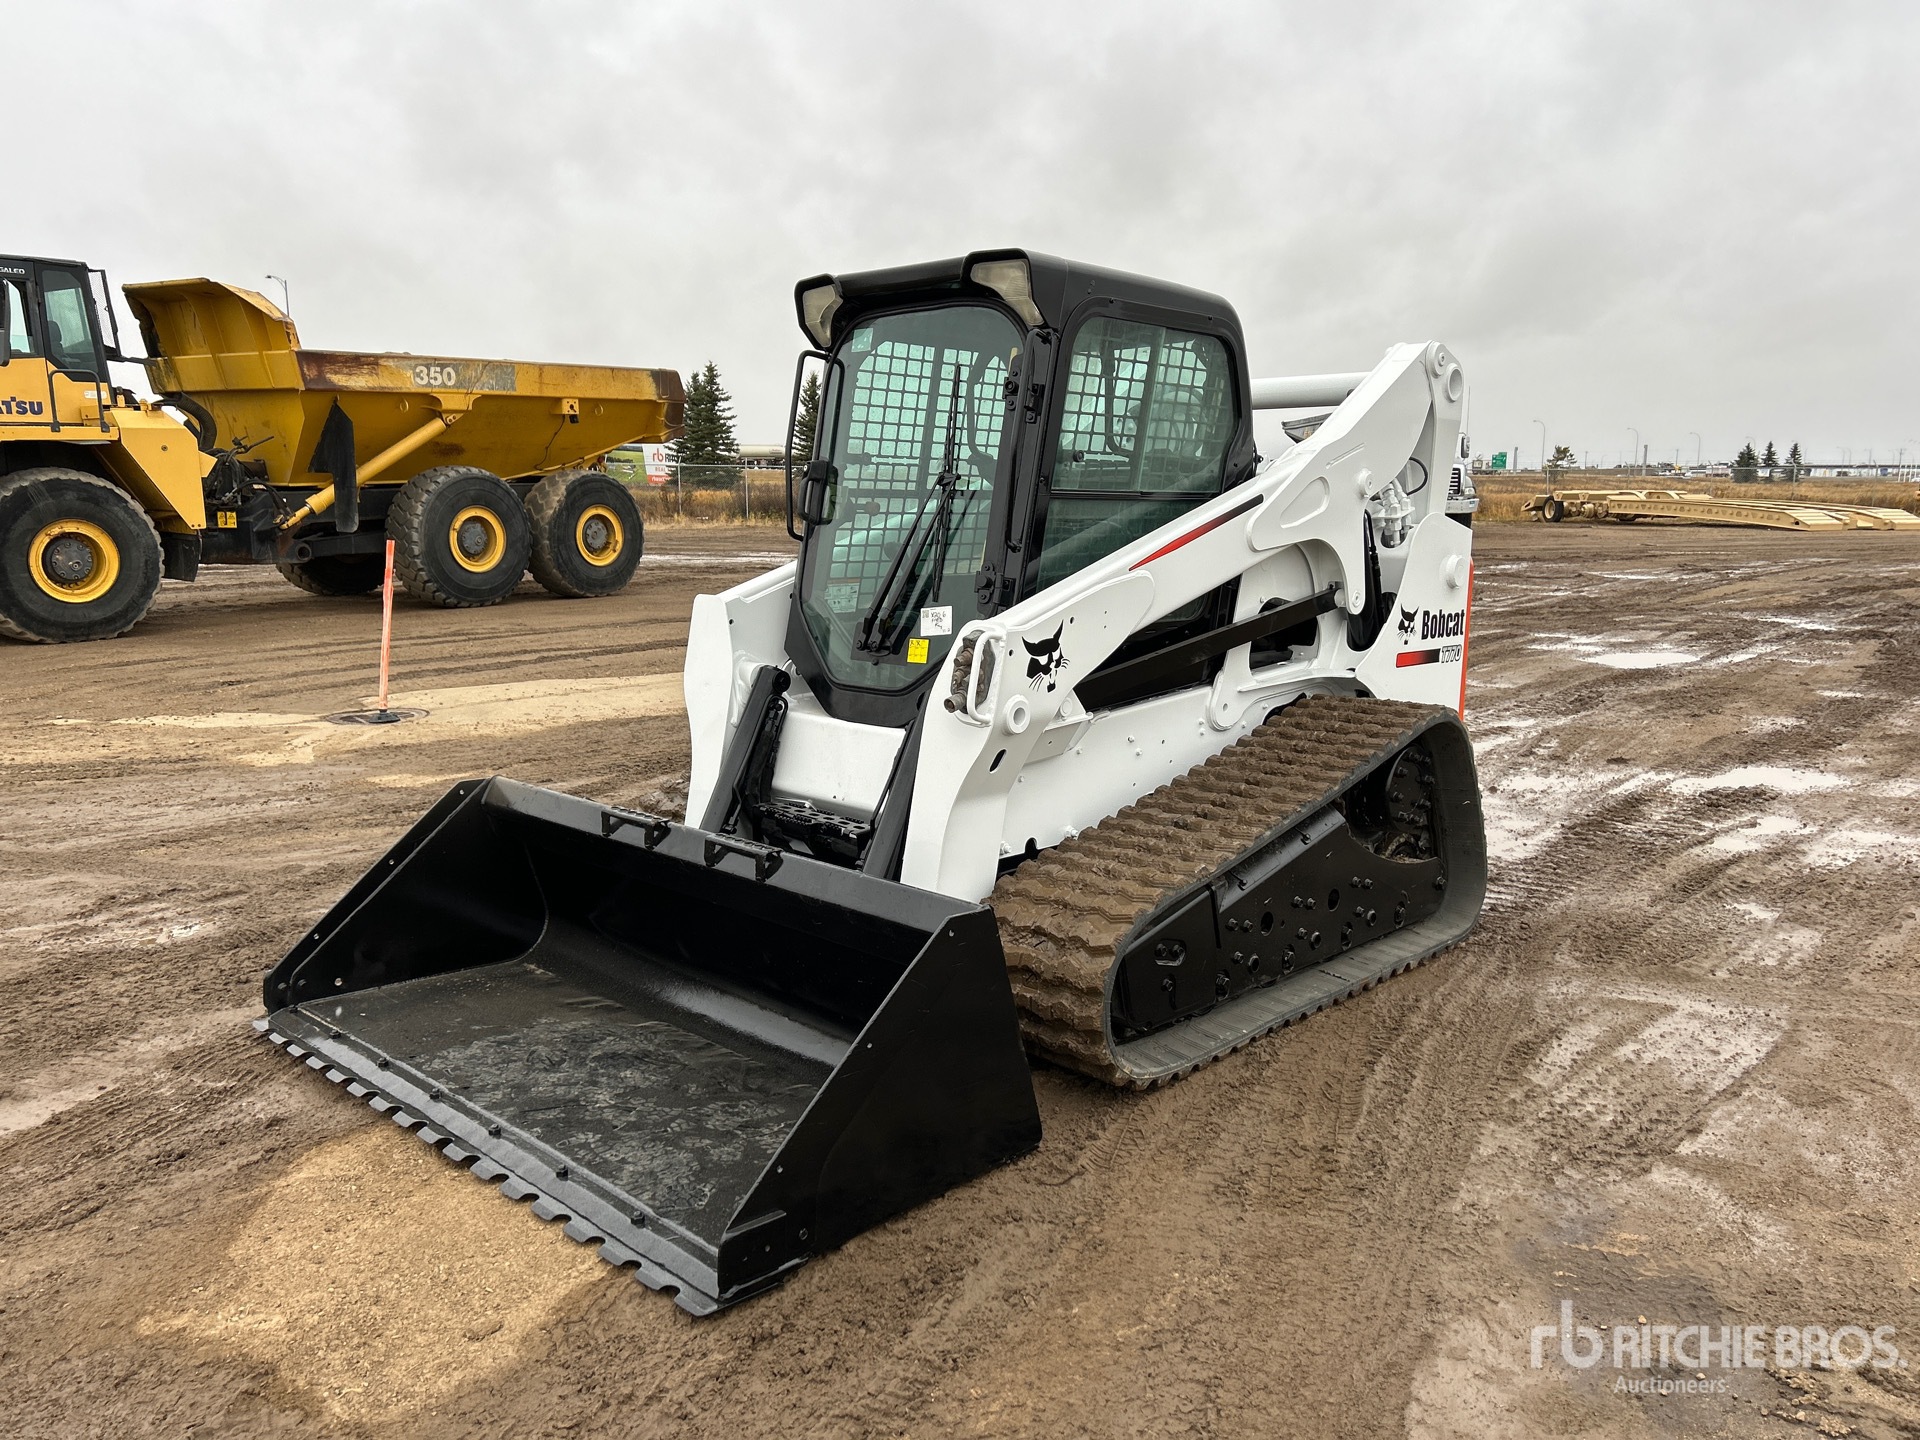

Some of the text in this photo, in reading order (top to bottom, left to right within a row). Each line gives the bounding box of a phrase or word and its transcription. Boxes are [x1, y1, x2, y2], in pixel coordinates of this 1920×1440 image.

[415, 366, 456, 386] 350
[1421, 609, 1465, 640] Bobcat
[1441, 644, 1462, 663] T770
